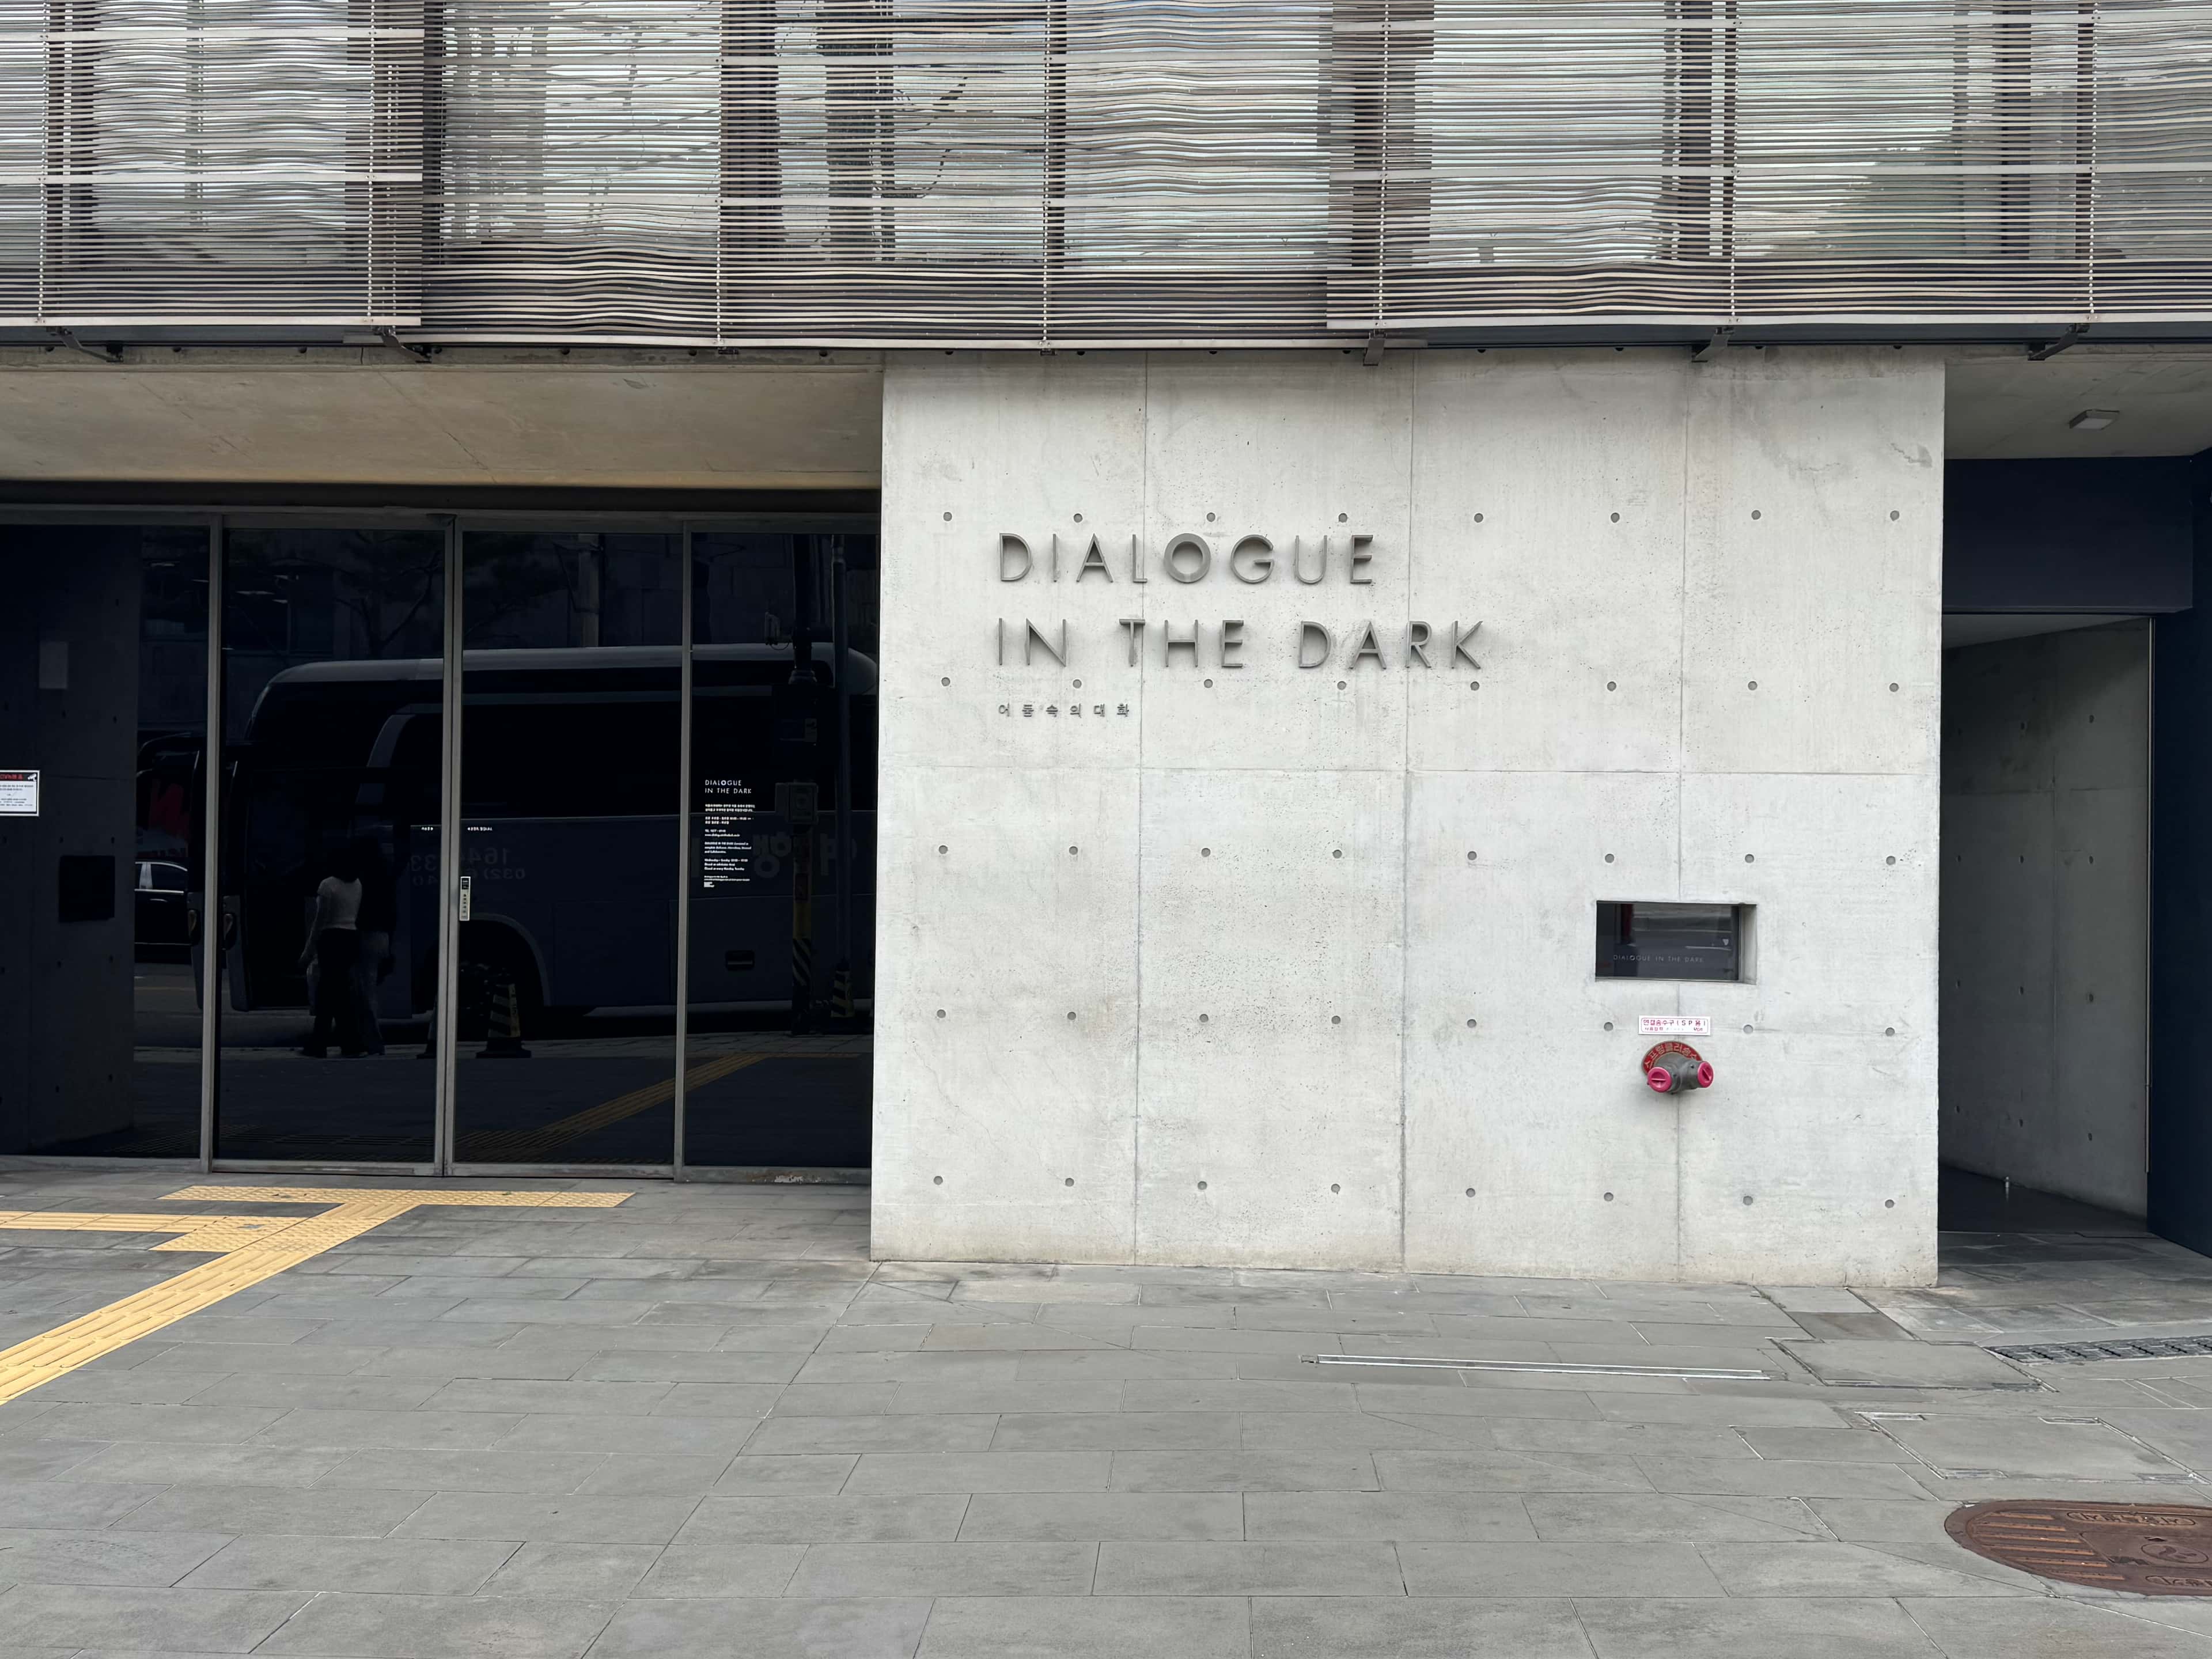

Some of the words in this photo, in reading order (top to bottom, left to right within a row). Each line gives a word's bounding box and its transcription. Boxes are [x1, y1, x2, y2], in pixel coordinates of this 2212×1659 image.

[999, 533, 1373, 584] DIALOGUE
[999, 618, 1066, 666] IN
[1119, 619, 1244, 668] THE
[1299, 620, 1483, 669] DARK
